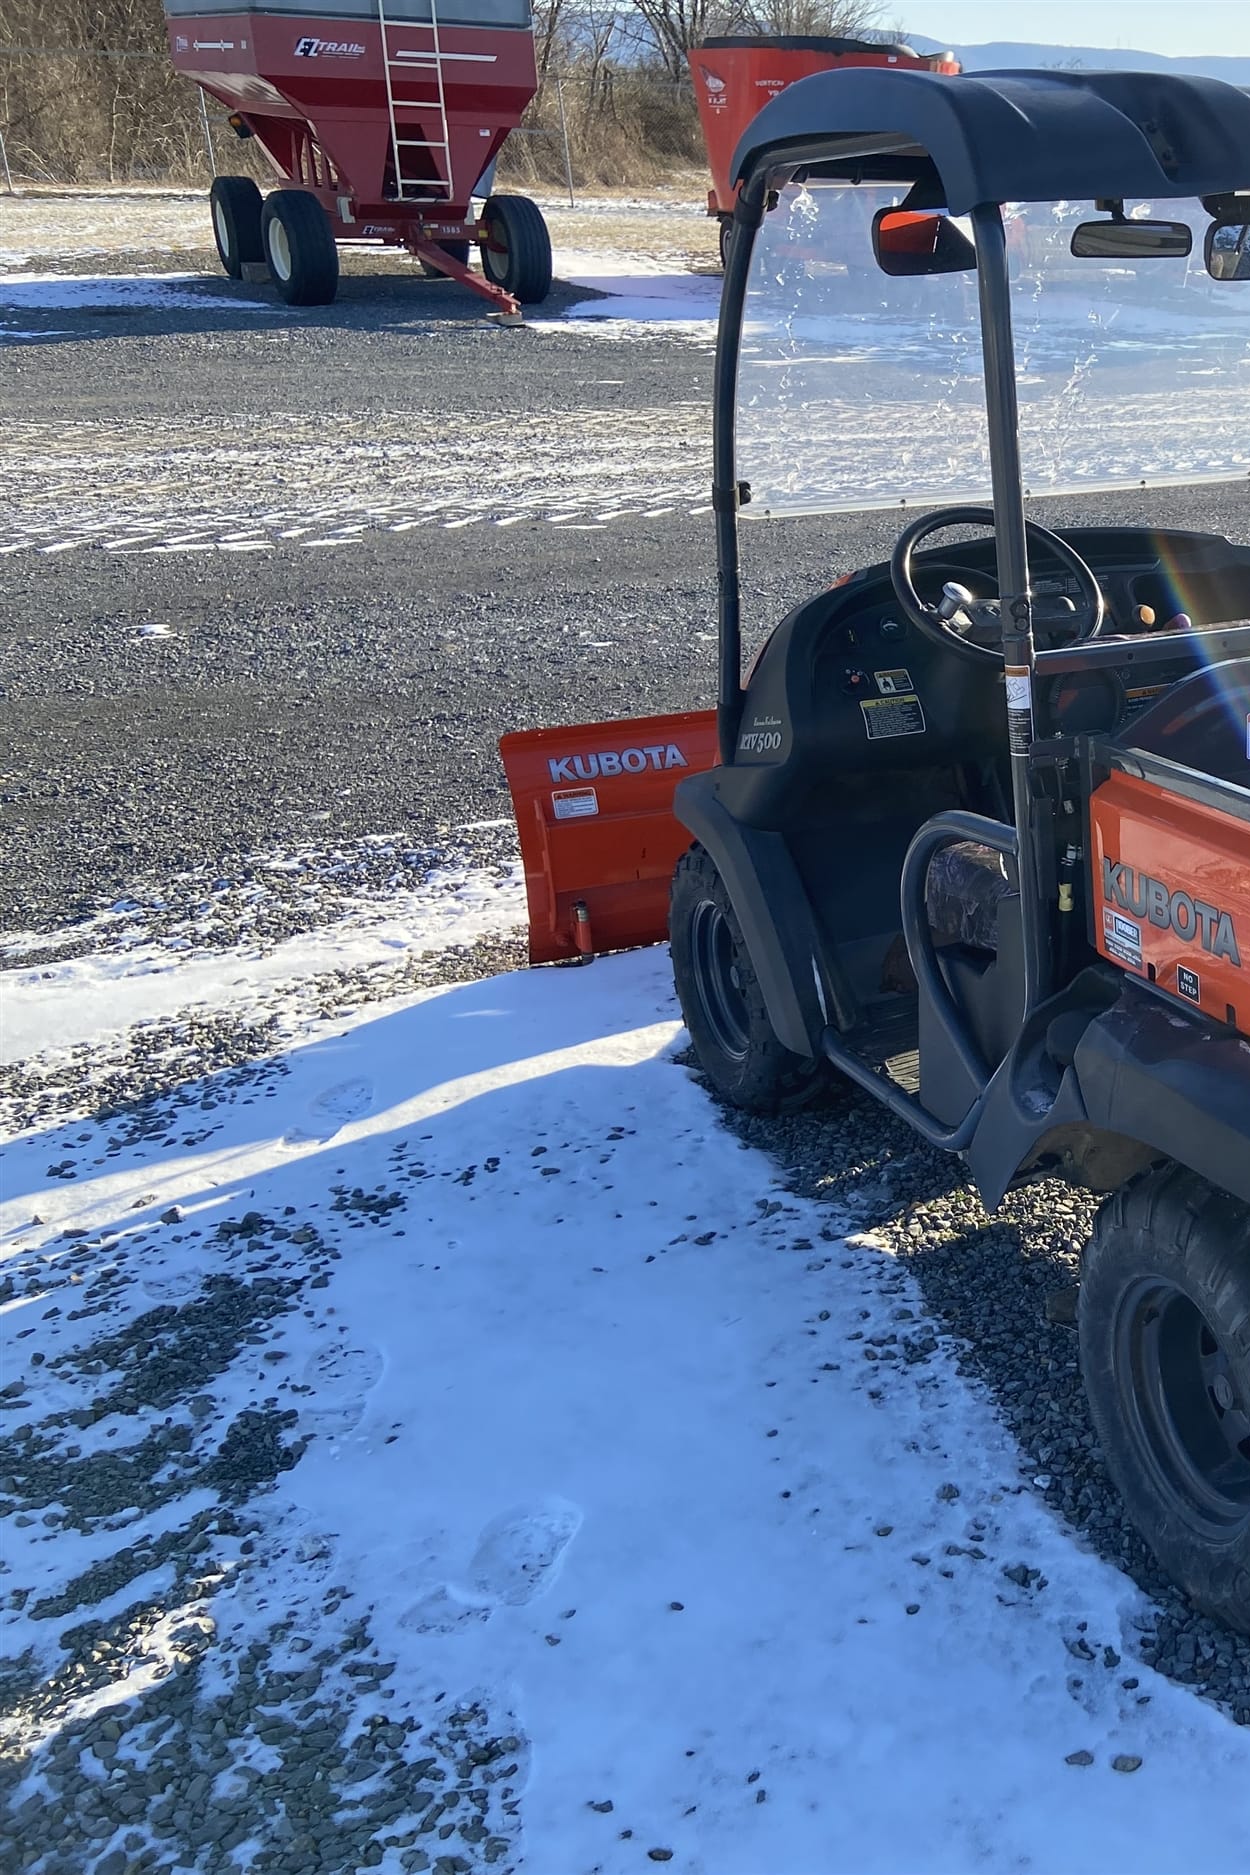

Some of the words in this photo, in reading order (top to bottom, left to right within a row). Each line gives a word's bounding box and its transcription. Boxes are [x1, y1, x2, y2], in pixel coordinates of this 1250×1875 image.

[740, 731, 782, 753] RTV500
[547, 743, 688, 783] KUBOTA
[1102, 855, 1242, 968] KUBOTA
[1180, 981, 1198, 996] STEP
[1183, 972, 1194, 984] NO
